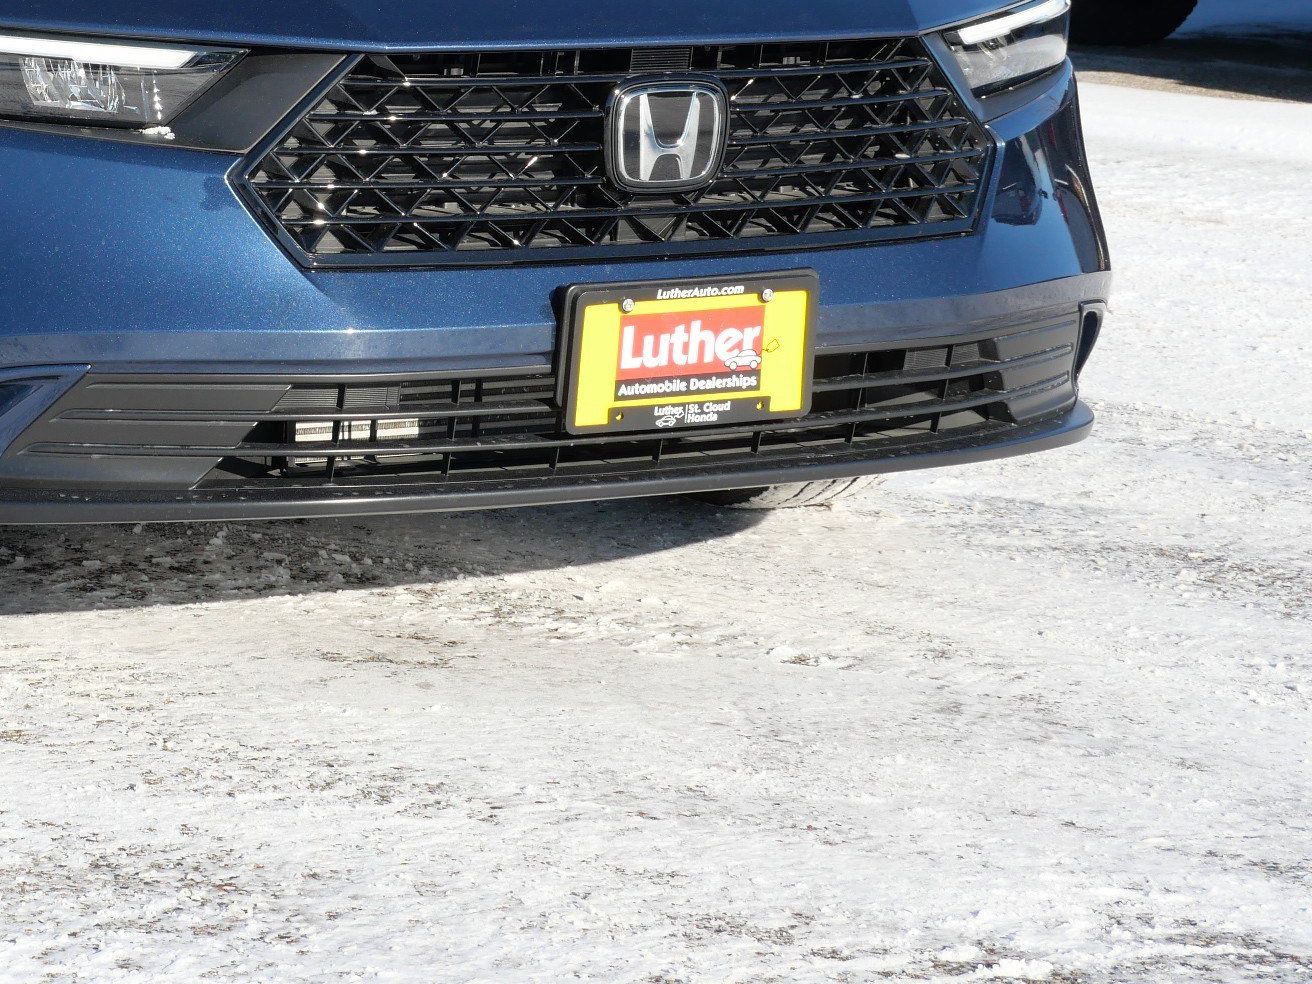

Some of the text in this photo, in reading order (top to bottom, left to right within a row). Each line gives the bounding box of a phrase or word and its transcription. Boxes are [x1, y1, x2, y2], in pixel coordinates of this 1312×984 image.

[656, 285, 745, 300] LutherAuto.com
[619, 319, 762, 370] Luther
[617, 374, 758, 397] Automobile Dealerships
[688, 403, 701, 414] St.
[703, 400, 732, 413] Cloud
[688, 412, 718, 423] Honda
